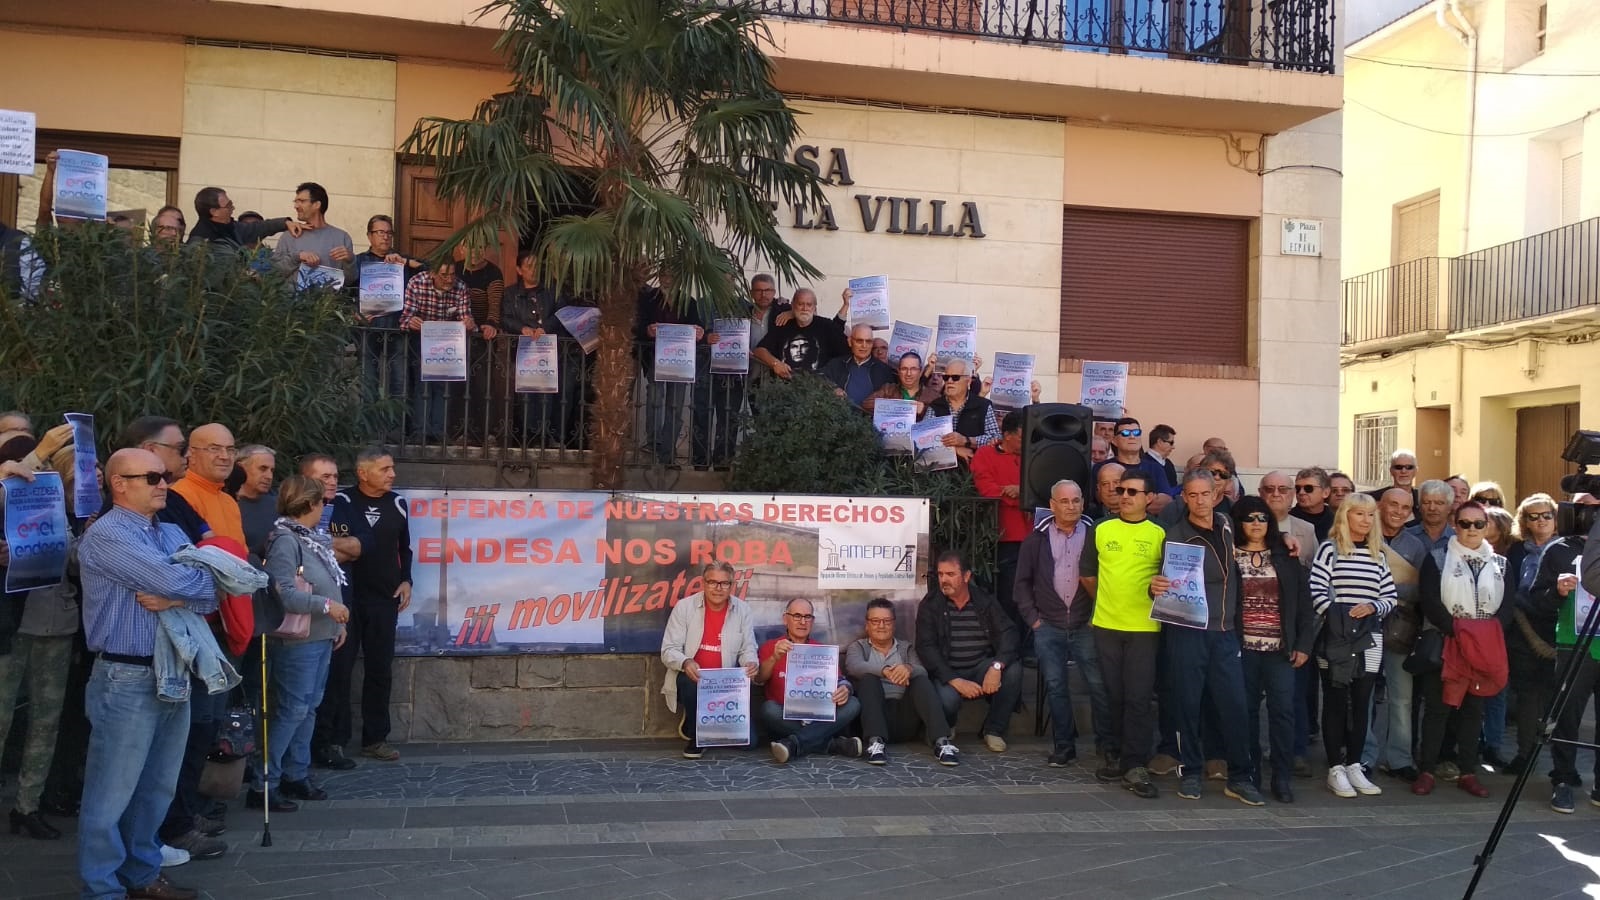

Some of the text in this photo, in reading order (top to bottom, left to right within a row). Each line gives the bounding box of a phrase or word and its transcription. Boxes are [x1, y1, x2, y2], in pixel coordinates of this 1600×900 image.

[793, 203, 839, 231] LA
[854, 194, 986, 238] VILLA
[410, 498, 905, 523] DEFENSA DE NUESTROS DERECHOS
[17, 519, 55, 539] enel
[15, 540, 65, 557] endesa
[418, 538, 794, 566] ENDESA NOS ROBA
[839, 544, 902, 559] AMEPEA
[508, 569, 704, 630] movilizate
[701, 713, 746, 725] endesa
